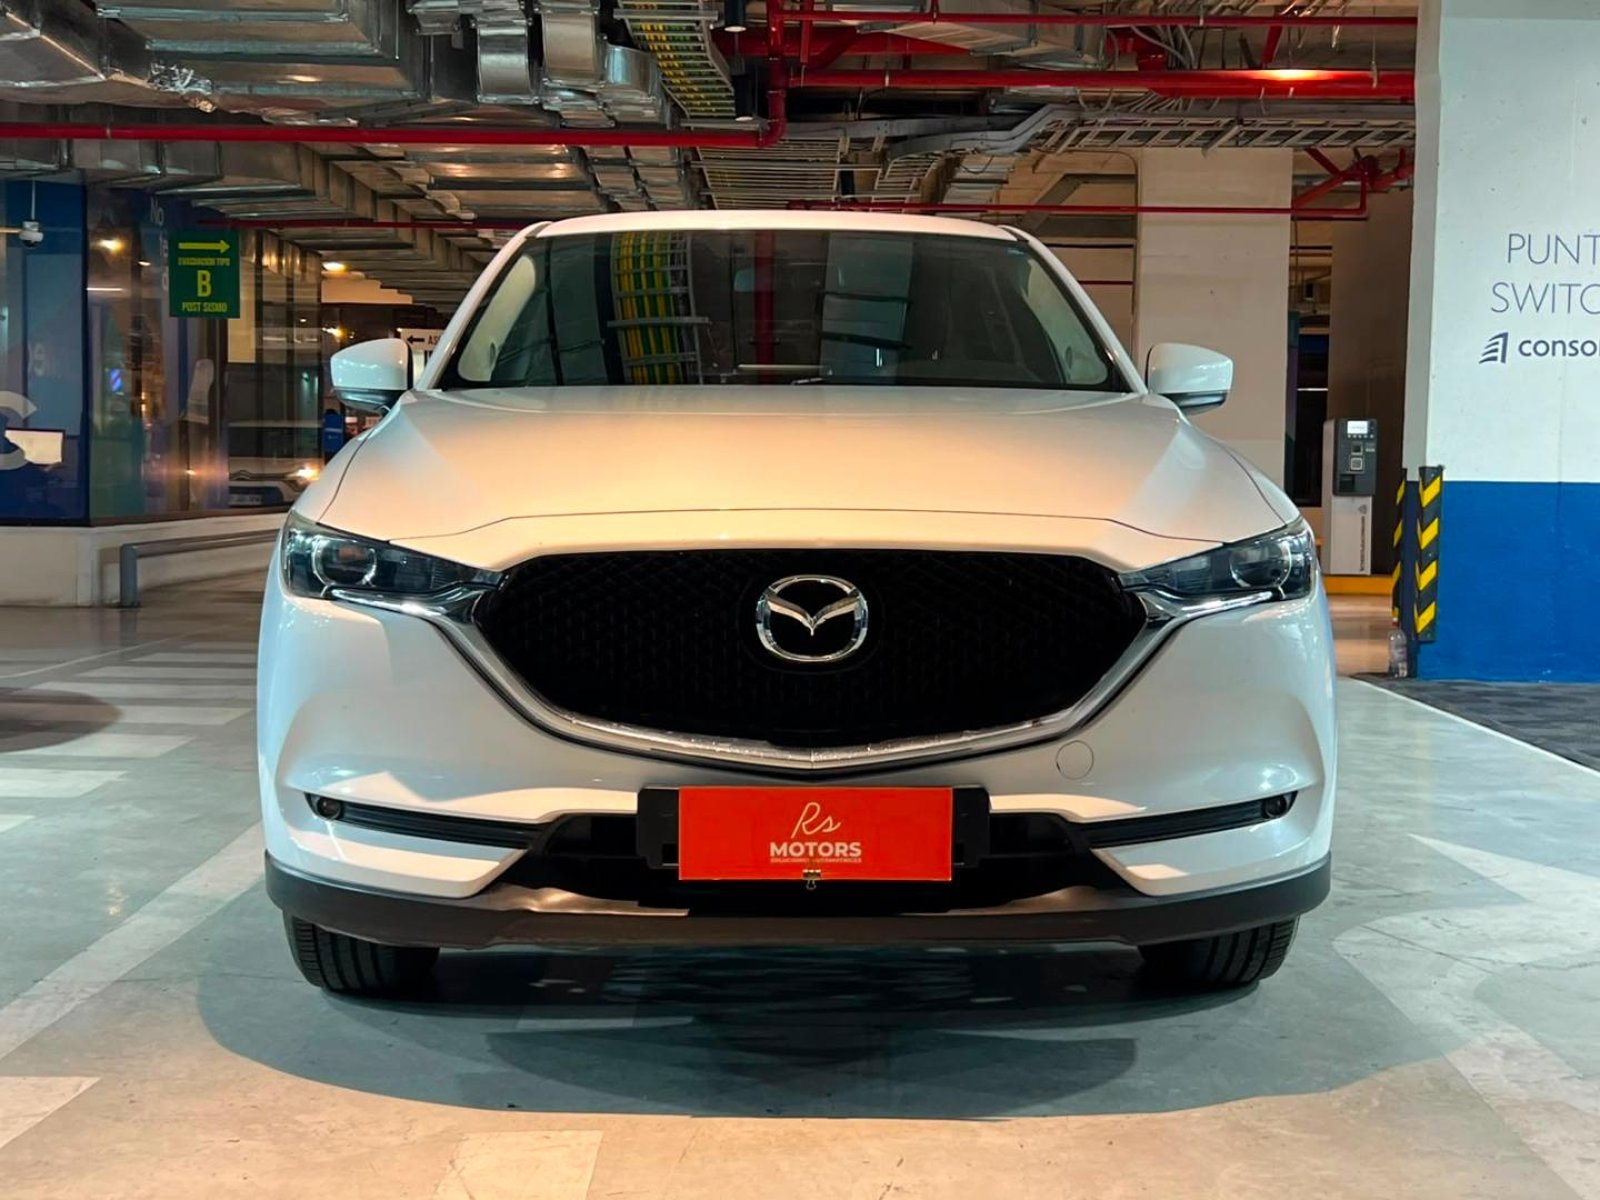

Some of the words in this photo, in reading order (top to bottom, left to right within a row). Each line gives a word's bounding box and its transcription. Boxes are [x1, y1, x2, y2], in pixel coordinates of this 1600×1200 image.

[197, 269, 212, 298] B
[182, 301, 201, 312] POST
[1518, 338, 1600, 357] conso
[790, 801, 842, 839] Rs
[769, 841, 862, 857] MOTORS
